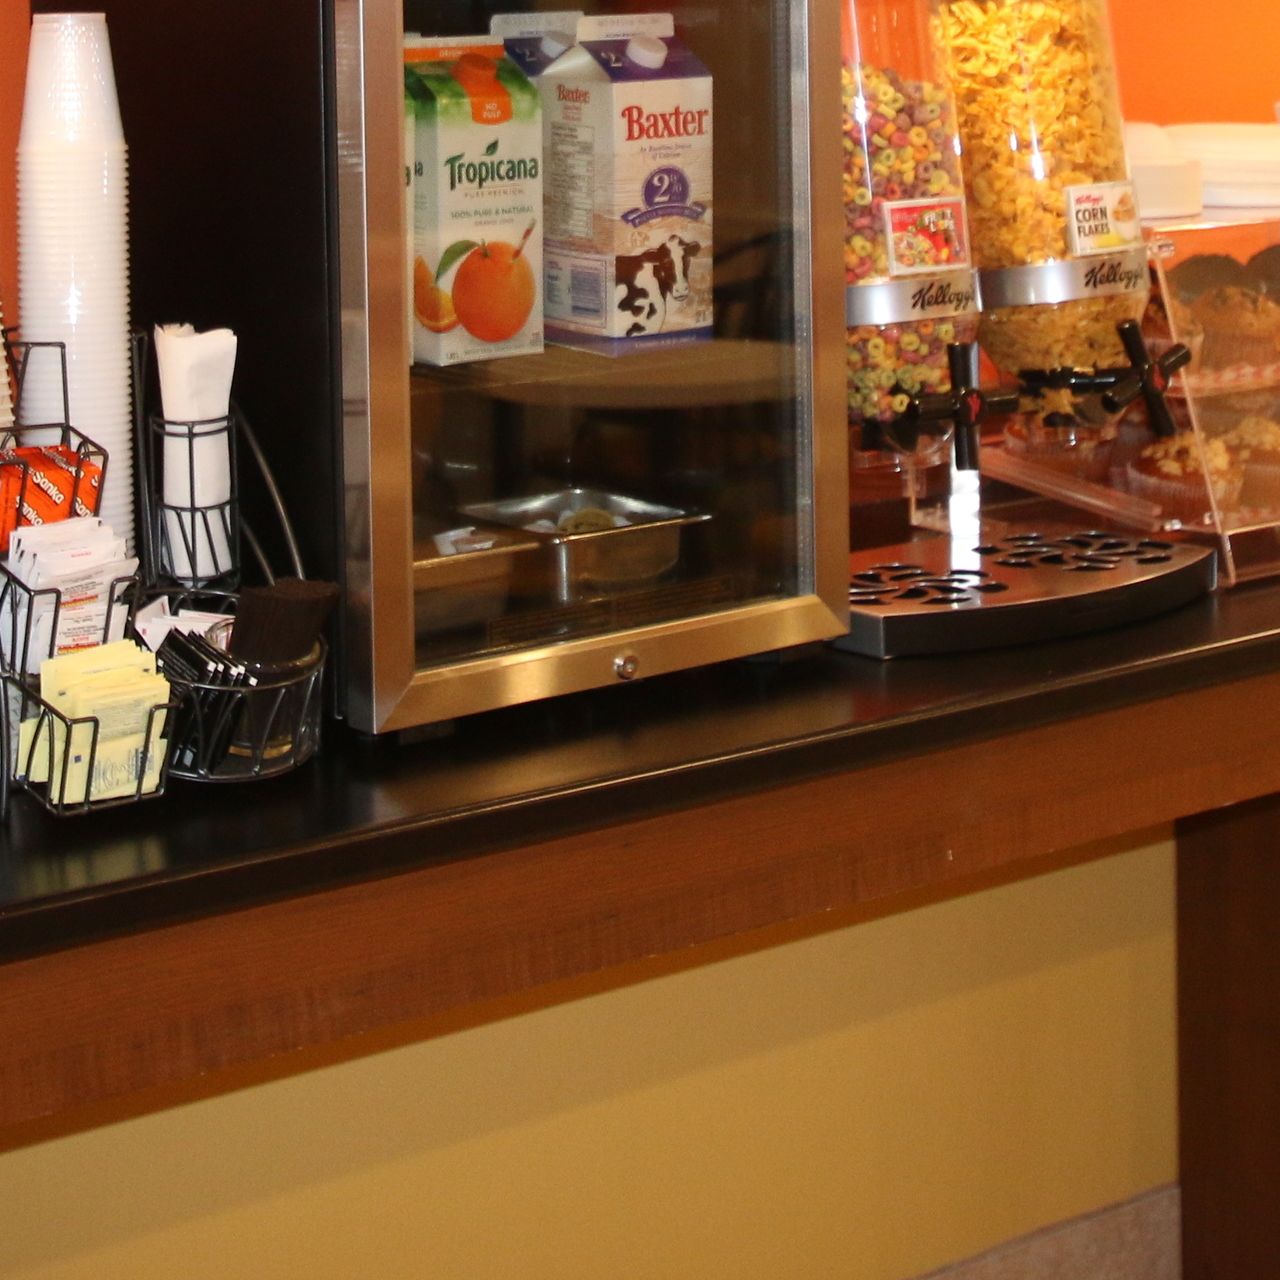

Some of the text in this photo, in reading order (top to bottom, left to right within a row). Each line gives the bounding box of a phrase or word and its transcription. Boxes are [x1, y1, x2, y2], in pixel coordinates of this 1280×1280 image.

[621, 105, 709, 141] Baxter
[443, 151, 539, 192] Tropicana
[1075, 206, 1108, 223] CORN
[1077, 223, 1111, 238] FLAKES
[32, 471, 65, 505] Sanka
[75, 498, 95, 518] San
